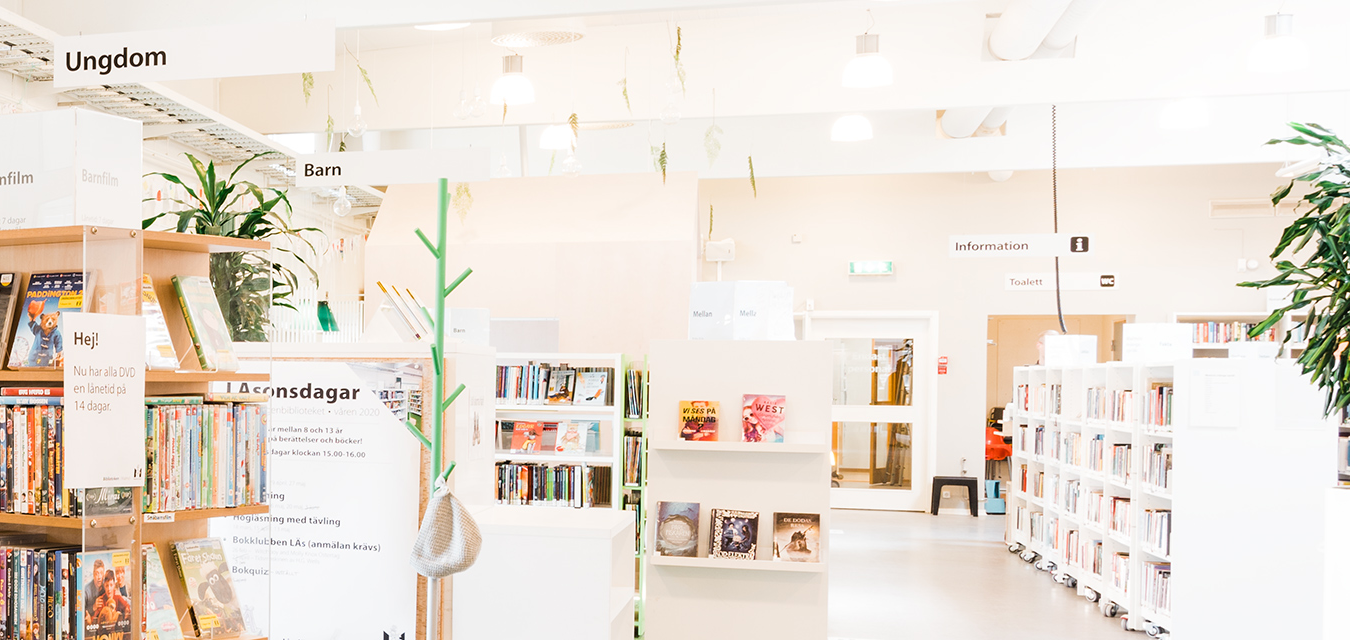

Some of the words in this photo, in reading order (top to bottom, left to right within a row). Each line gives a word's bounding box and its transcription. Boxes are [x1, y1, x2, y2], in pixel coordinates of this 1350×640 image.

[65, 47, 167, 75] Ungdom
[304, 163, 342, 177] Barn
[82, 169, 119, 187] Barnfilm
[7, 216, 26, 225] dagar
[955, 241, 1029, 251] Information
[1009, 278, 1043, 286] Toalett
[1101, 277, 1115, 285] WC
[74, 331, 99, 349] Hej!
[73, 366, 87, 377] Nu
[89, 366, 103, 378] har
[103, 366, 117, 378] alla
[119, 367, 136, 378] DVD
[73, 385, 86, 394] en
[87, 382, 115, 394] lånetid
[116, 383, 126, 398] på
[74, 400, 85, 411] 14
[87, 400, 112, 414] dagar.
[334, 407, 358, 416] våren
[359, 408, 380, 416] 2020
[755, 404, 784, 414] WEST
[278, 436, 319, 444] berättelser
[286, 516, 306, 524] med
[309, 516, 341, 527] tävling
[232, 536, 287, 546] Bokklubben
[290, 538, 305, 547] LÄs
[308, 539, 350, 550] (anmälan
[353, 541, 381, 552] krävs)
[181, 552, 201, 564] Fåret
[232, 566, 269, 577] Bokquiz
